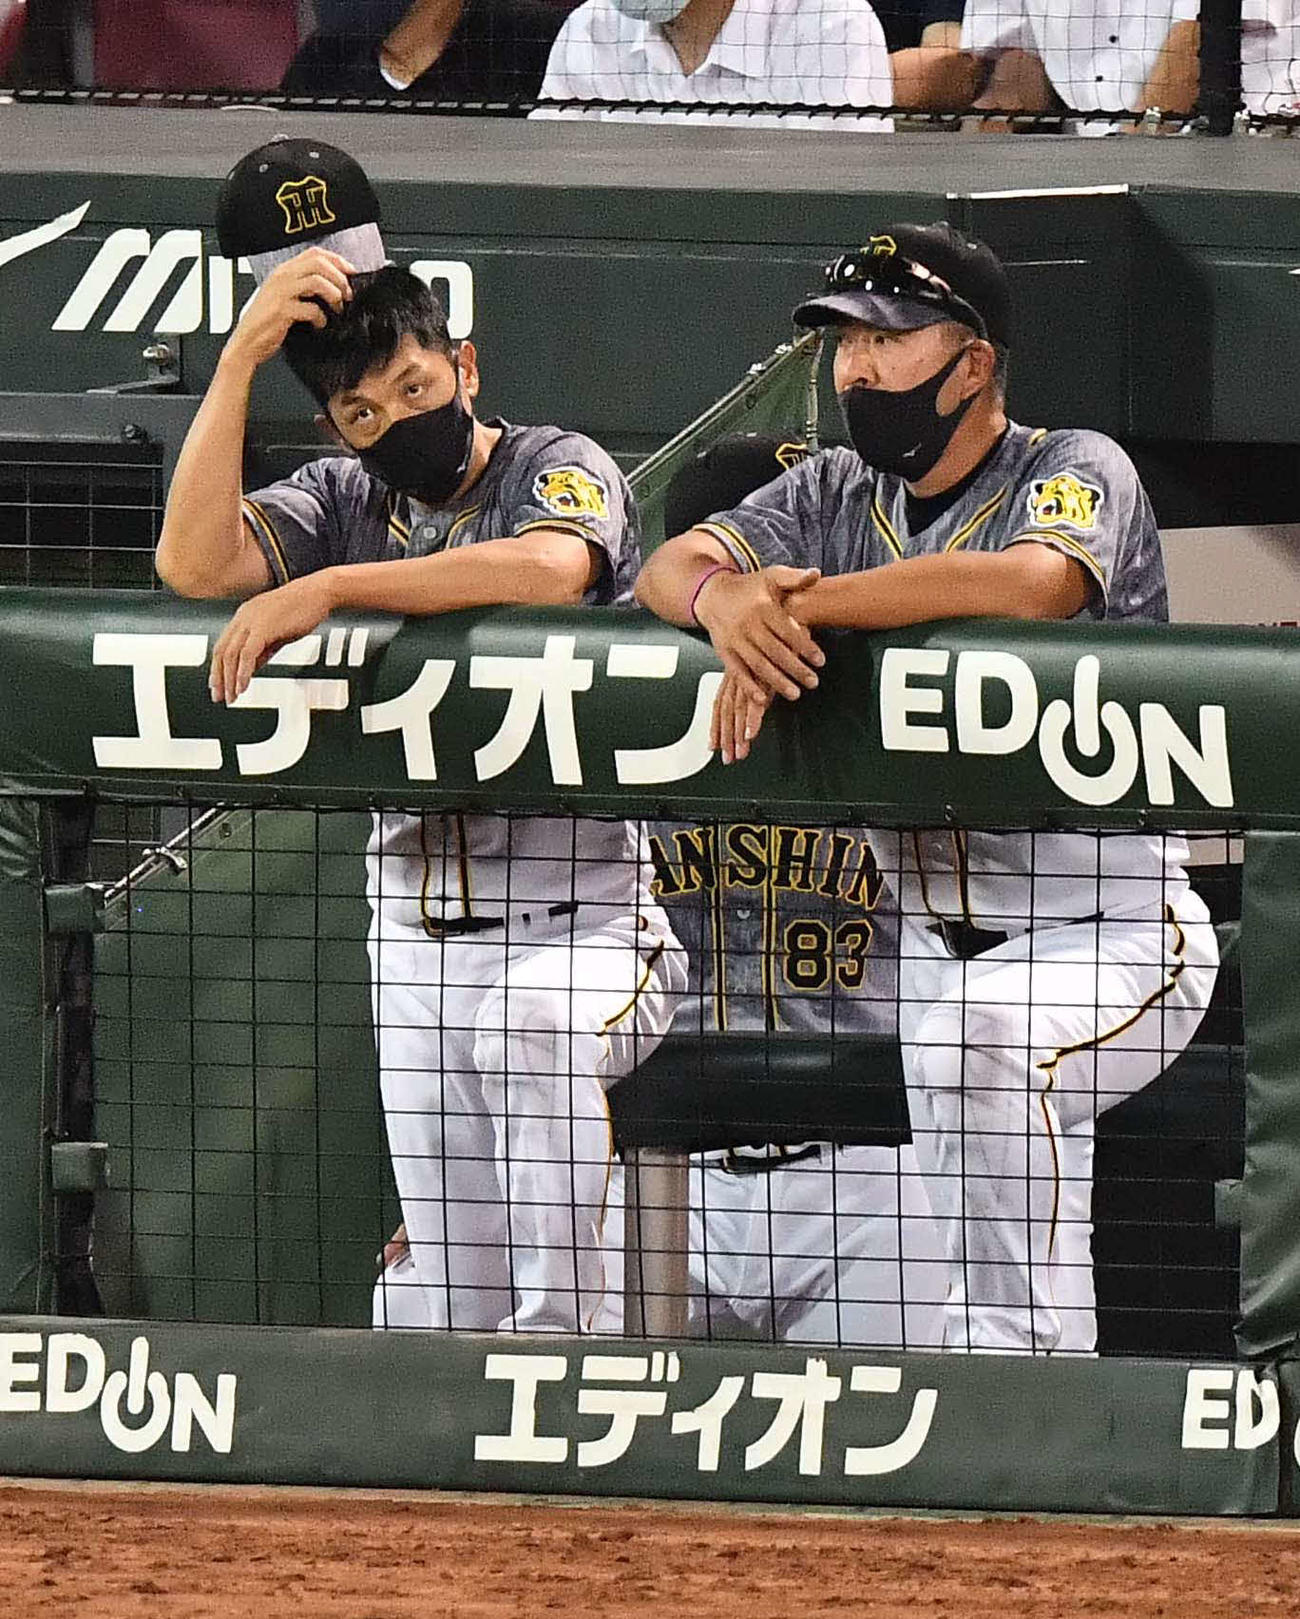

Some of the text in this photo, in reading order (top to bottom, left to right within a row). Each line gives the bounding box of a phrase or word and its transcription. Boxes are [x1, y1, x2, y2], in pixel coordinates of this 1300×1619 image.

[91, 627, 725, 786] エディオン
[783, 918, 873, 991] 83
[474, 1351, 938, 1476] エディオン
[1181, 1368, 1300, 1471] ED
